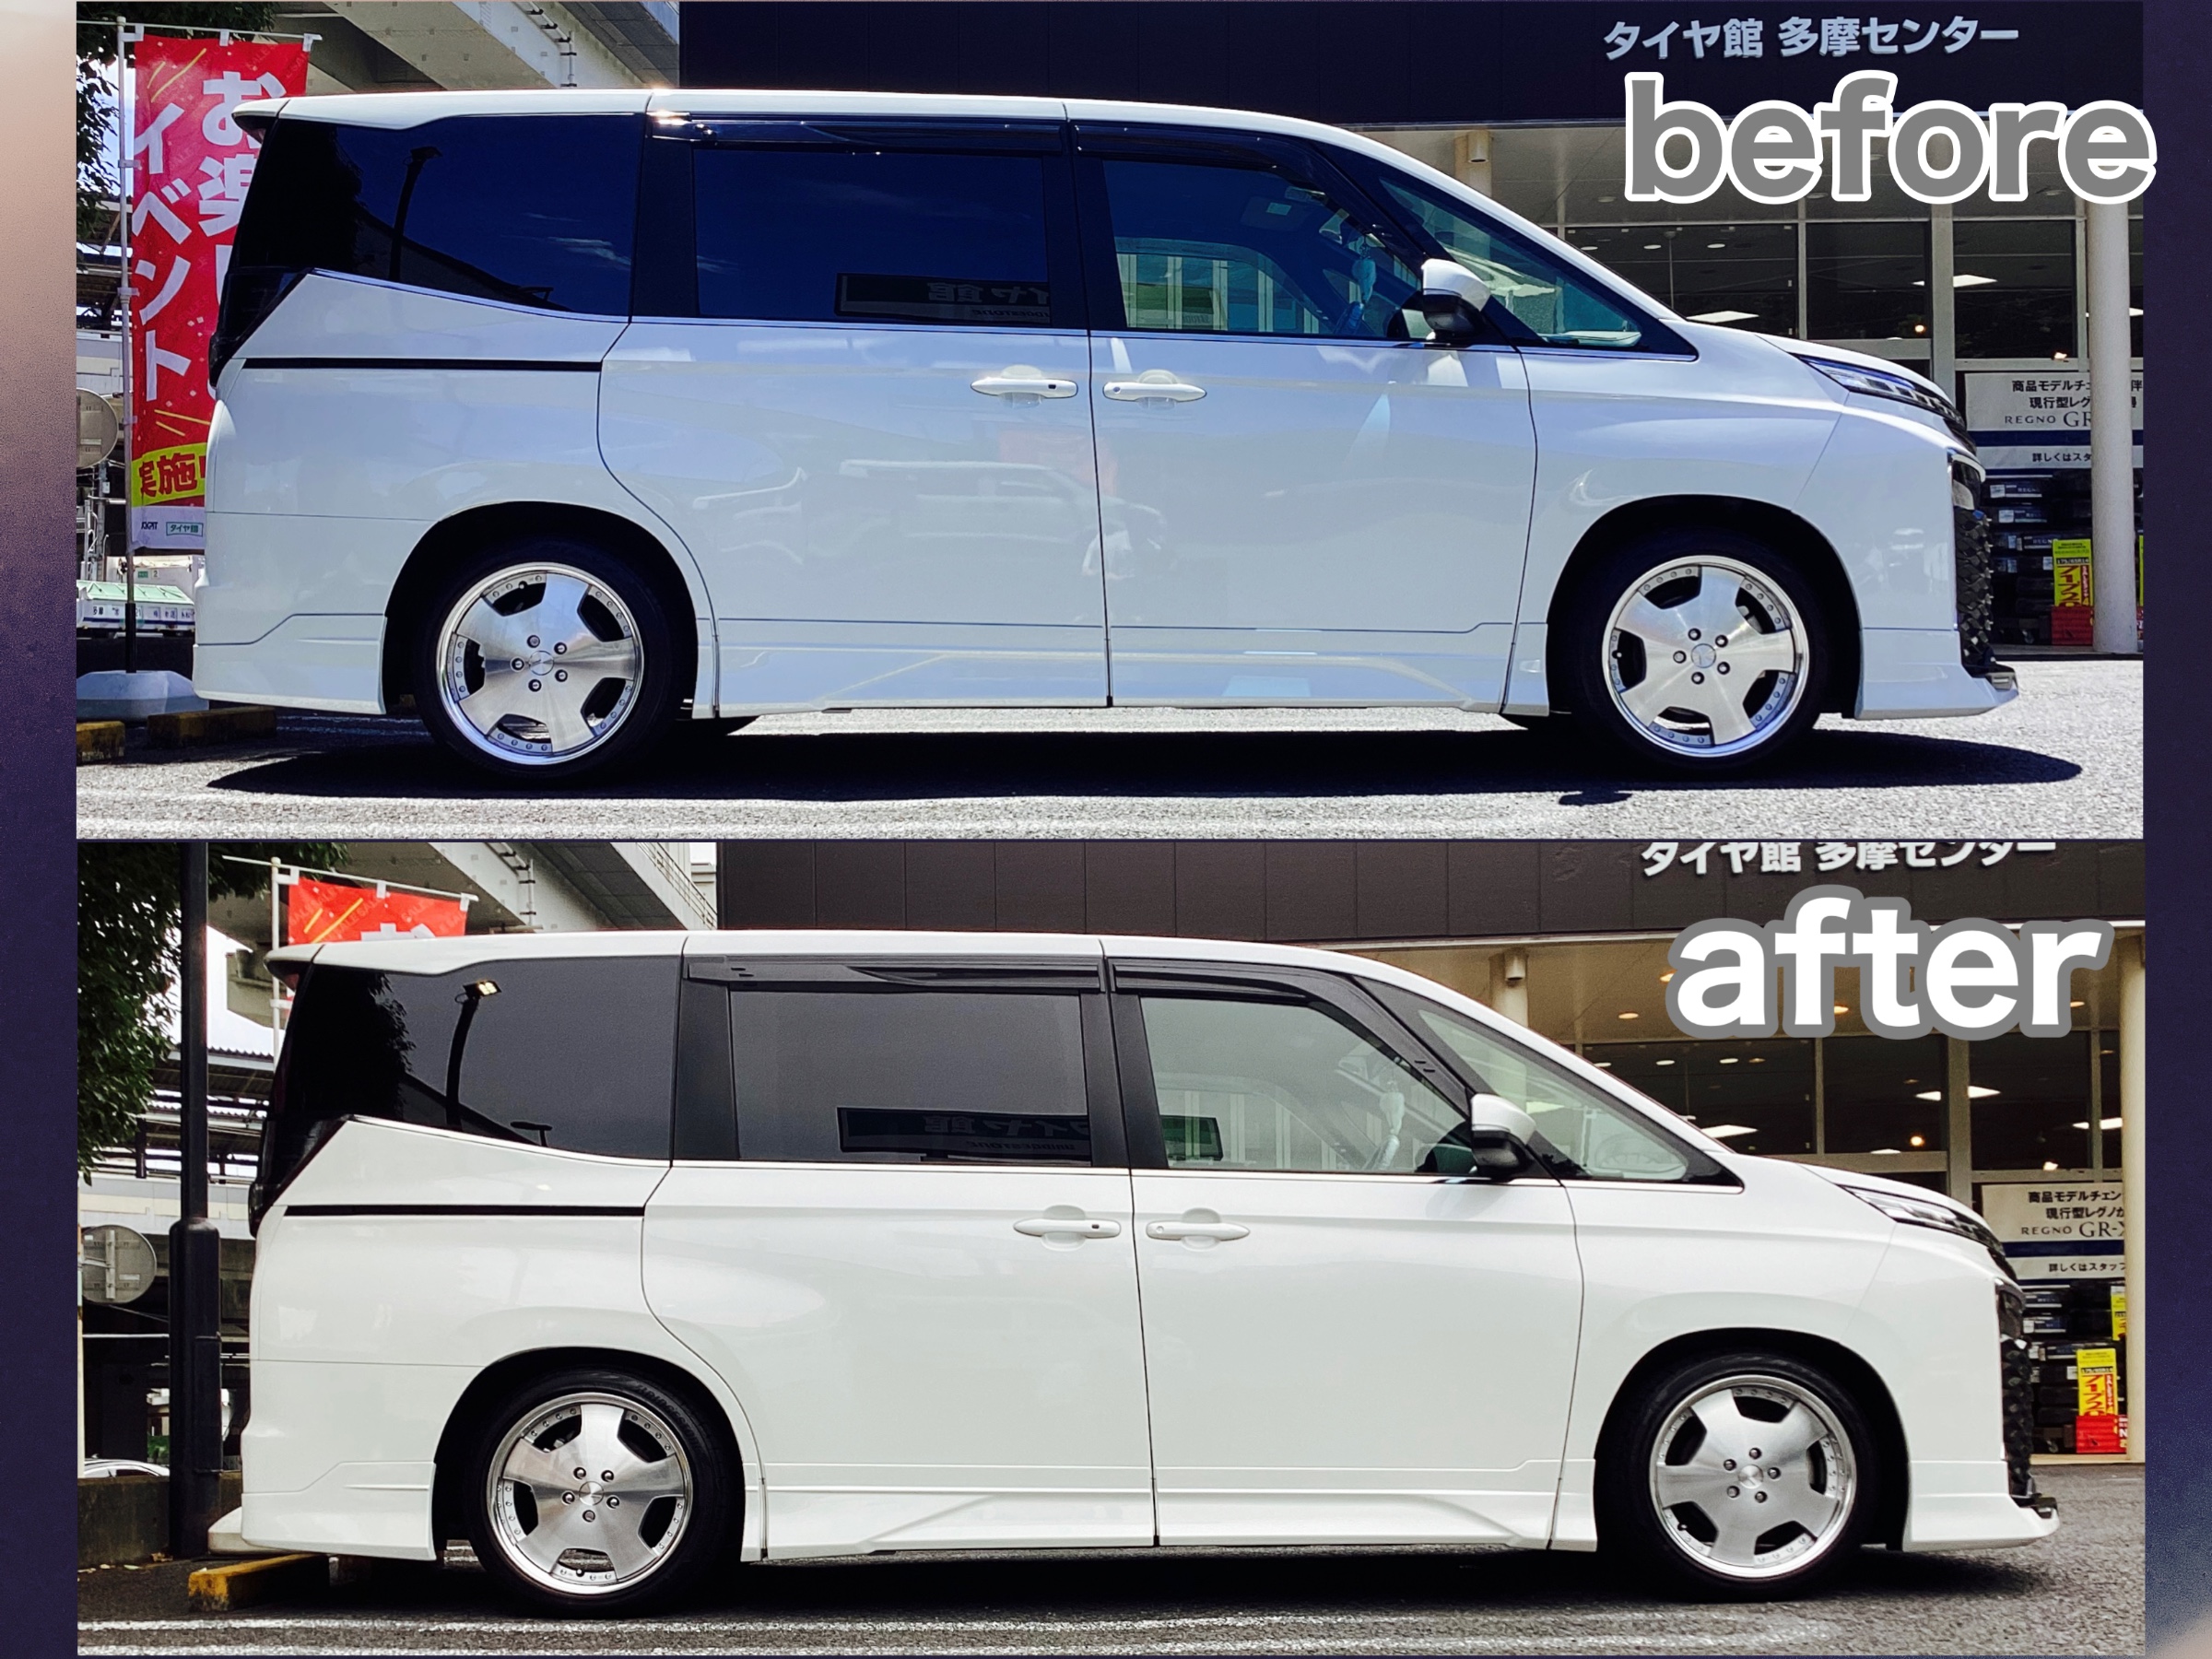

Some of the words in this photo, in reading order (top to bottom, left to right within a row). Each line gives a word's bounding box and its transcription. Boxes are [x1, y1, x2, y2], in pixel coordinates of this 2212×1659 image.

[1604, 18, 1764, 60] タイヤ館
[1779, 15, 2019, 56] 多摩センター
[132, 102, 193, 402] イベント
[2005, 415, 2056, 424] REGNO
[138, 453, 206, 498] 実施
[2021, 1226, 2072, 1236] REGNO
